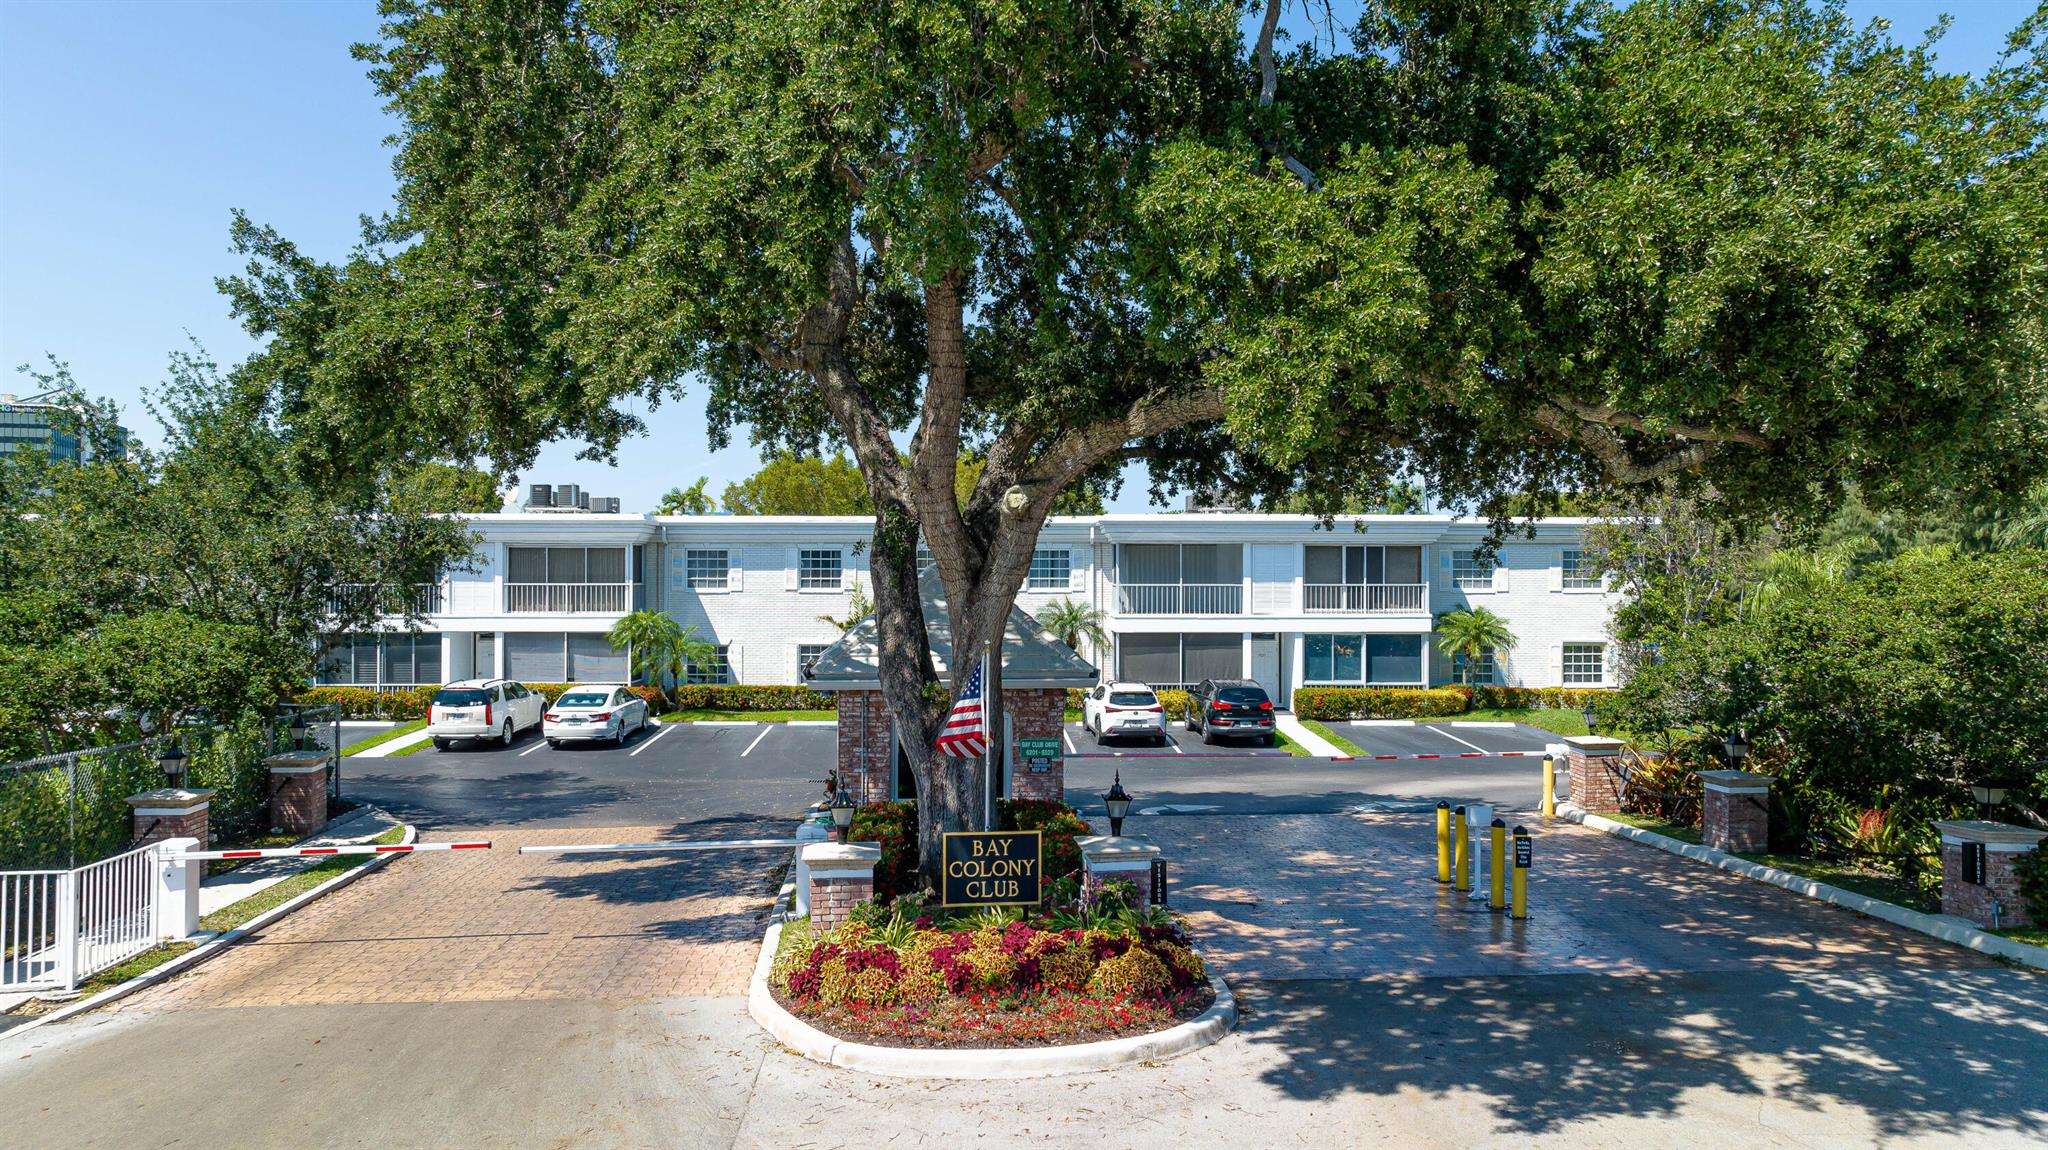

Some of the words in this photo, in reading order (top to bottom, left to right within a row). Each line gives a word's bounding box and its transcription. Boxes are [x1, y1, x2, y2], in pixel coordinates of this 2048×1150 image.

[972, 839, 1013, 857] BAY
[949, 859, 1036, 878] COLONY
[966, 880, 1020, 898] CLUB
